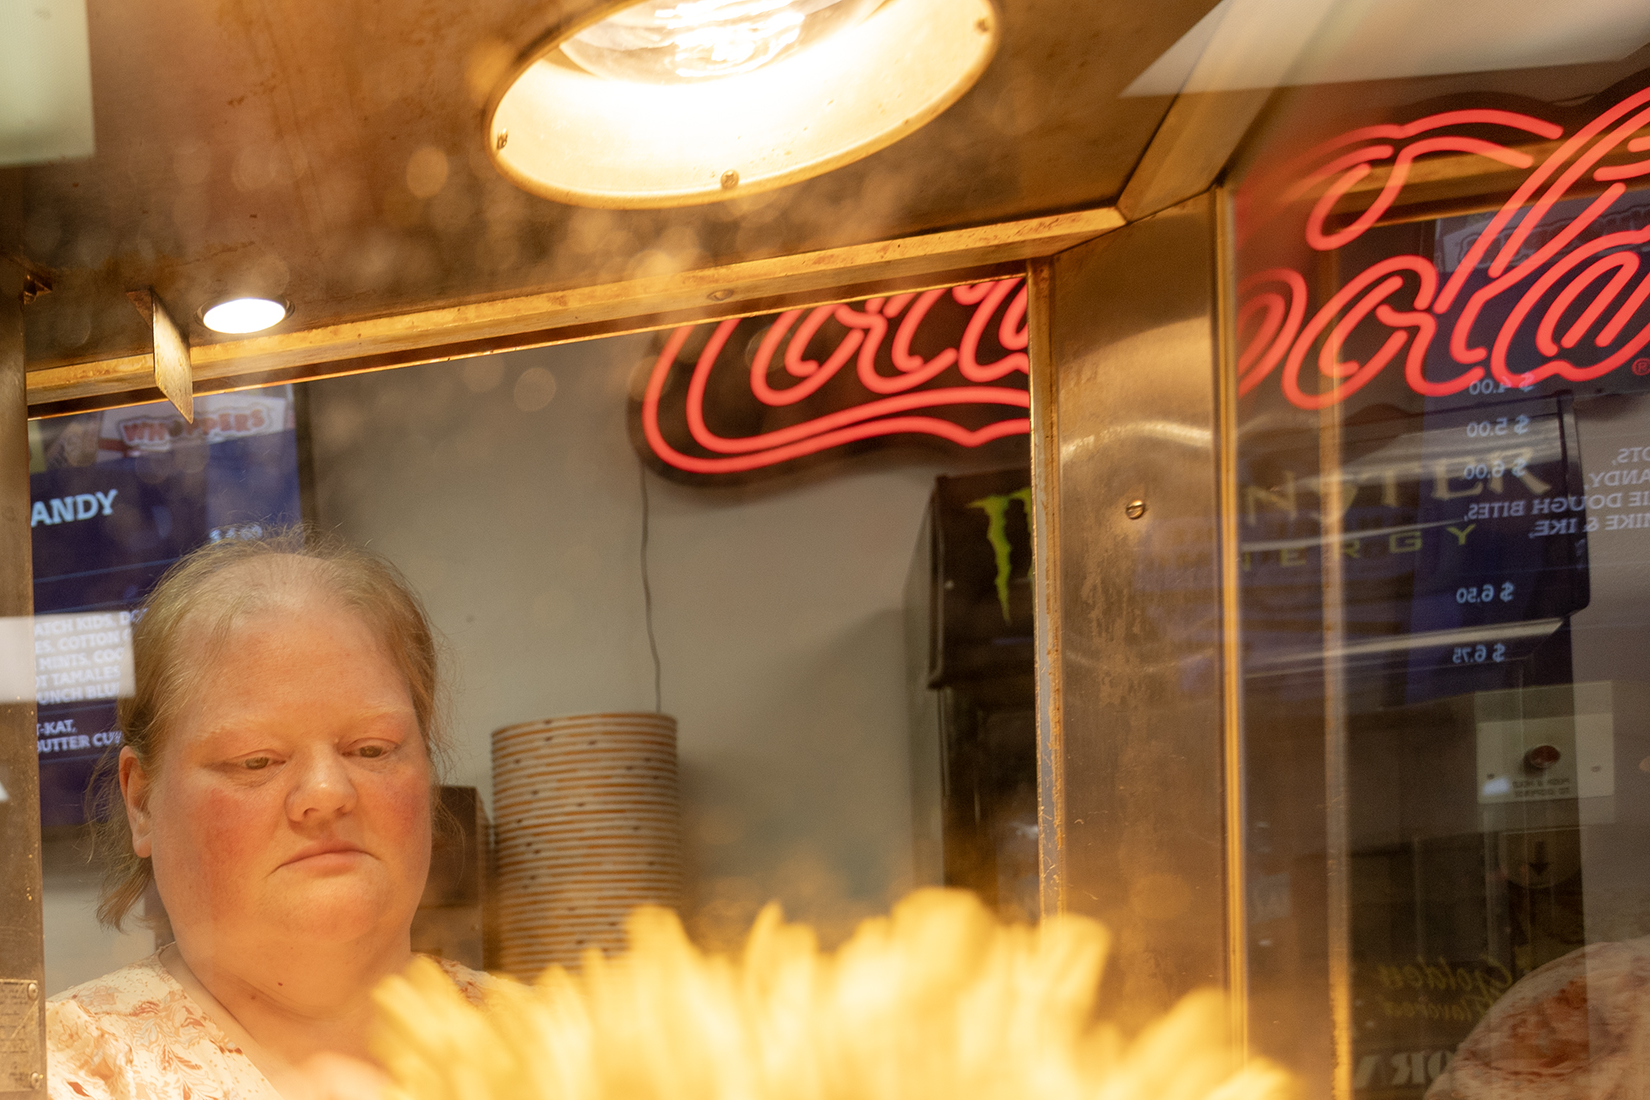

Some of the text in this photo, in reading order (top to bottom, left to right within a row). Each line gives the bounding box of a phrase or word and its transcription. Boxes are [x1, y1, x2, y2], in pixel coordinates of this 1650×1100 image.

[57, 630, 120, 651] COTTON
[53, 665, 121, 685] TAMALES
[37, 688, 83, 705] UNCH
